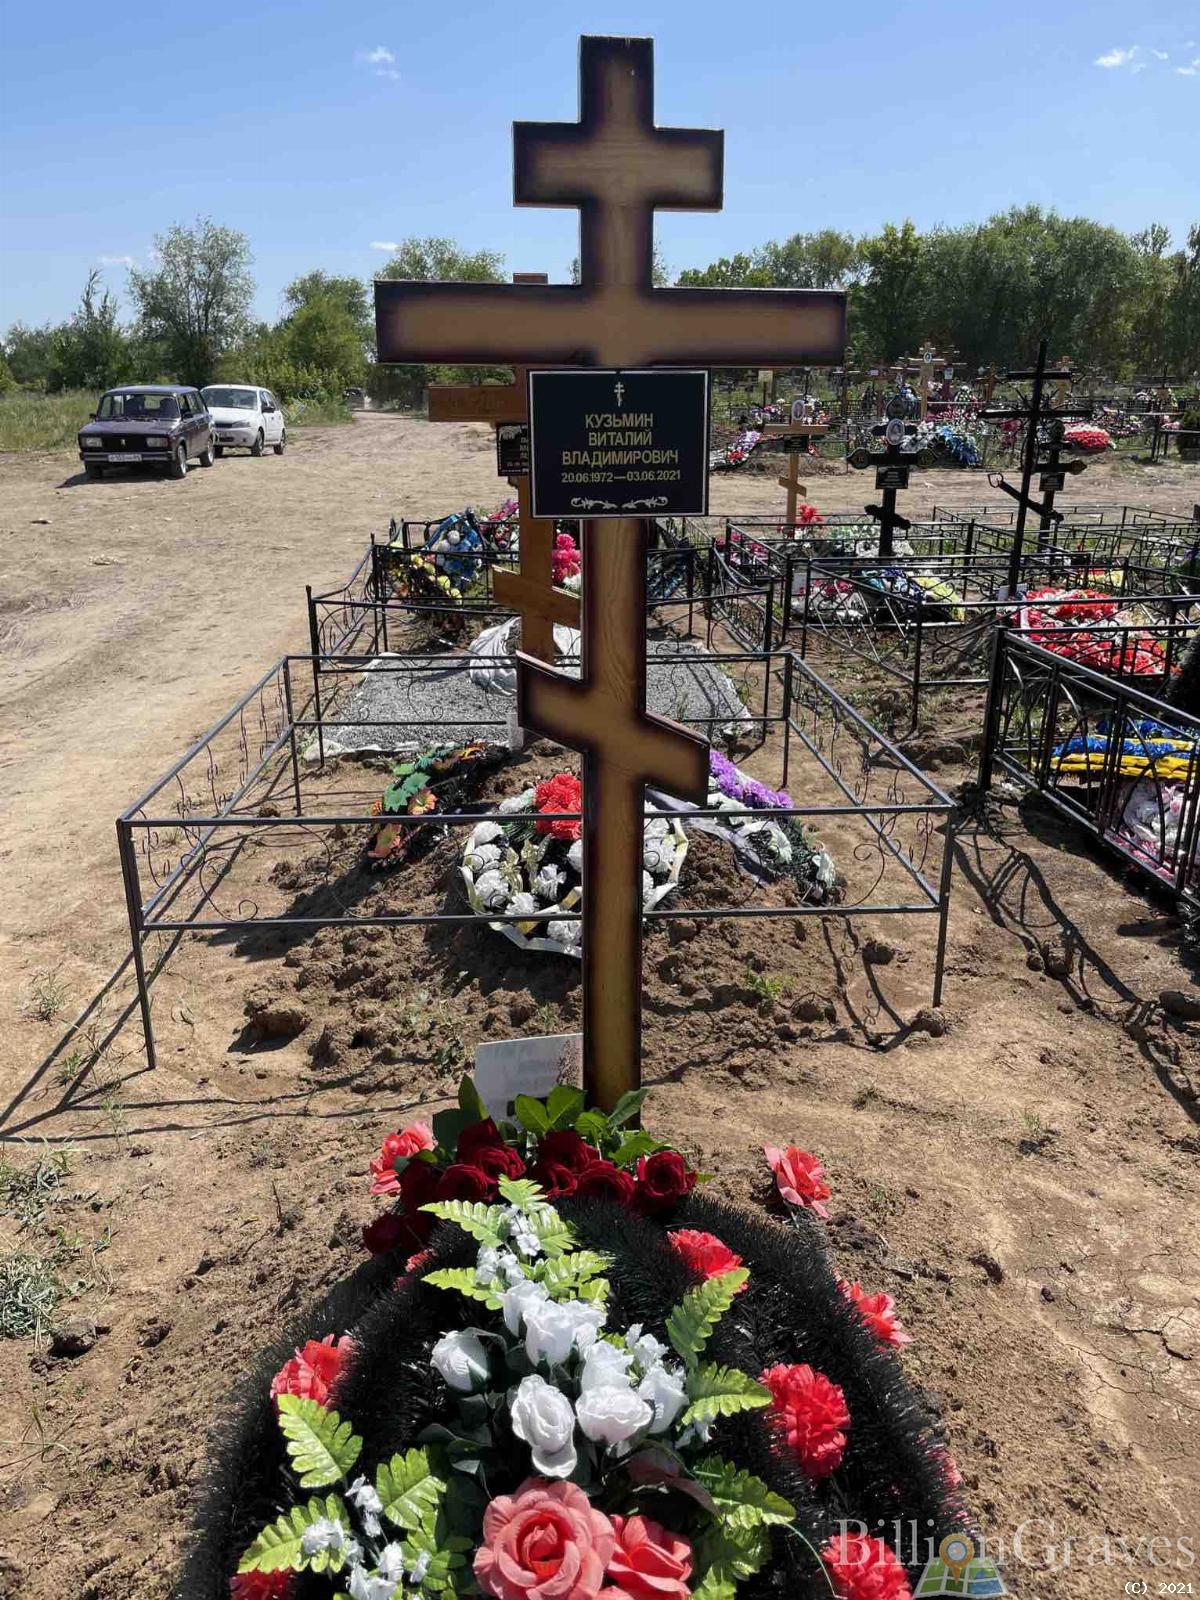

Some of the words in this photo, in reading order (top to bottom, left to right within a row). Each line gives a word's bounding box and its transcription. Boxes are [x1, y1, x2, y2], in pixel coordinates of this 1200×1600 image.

[585, 413, 654, 428] КУЗЬМИН
[588, 428, 653, 446] ВИТАЛИЙ
[561, 450, 679, 468] ВЛАДИМИРОВИЧ
